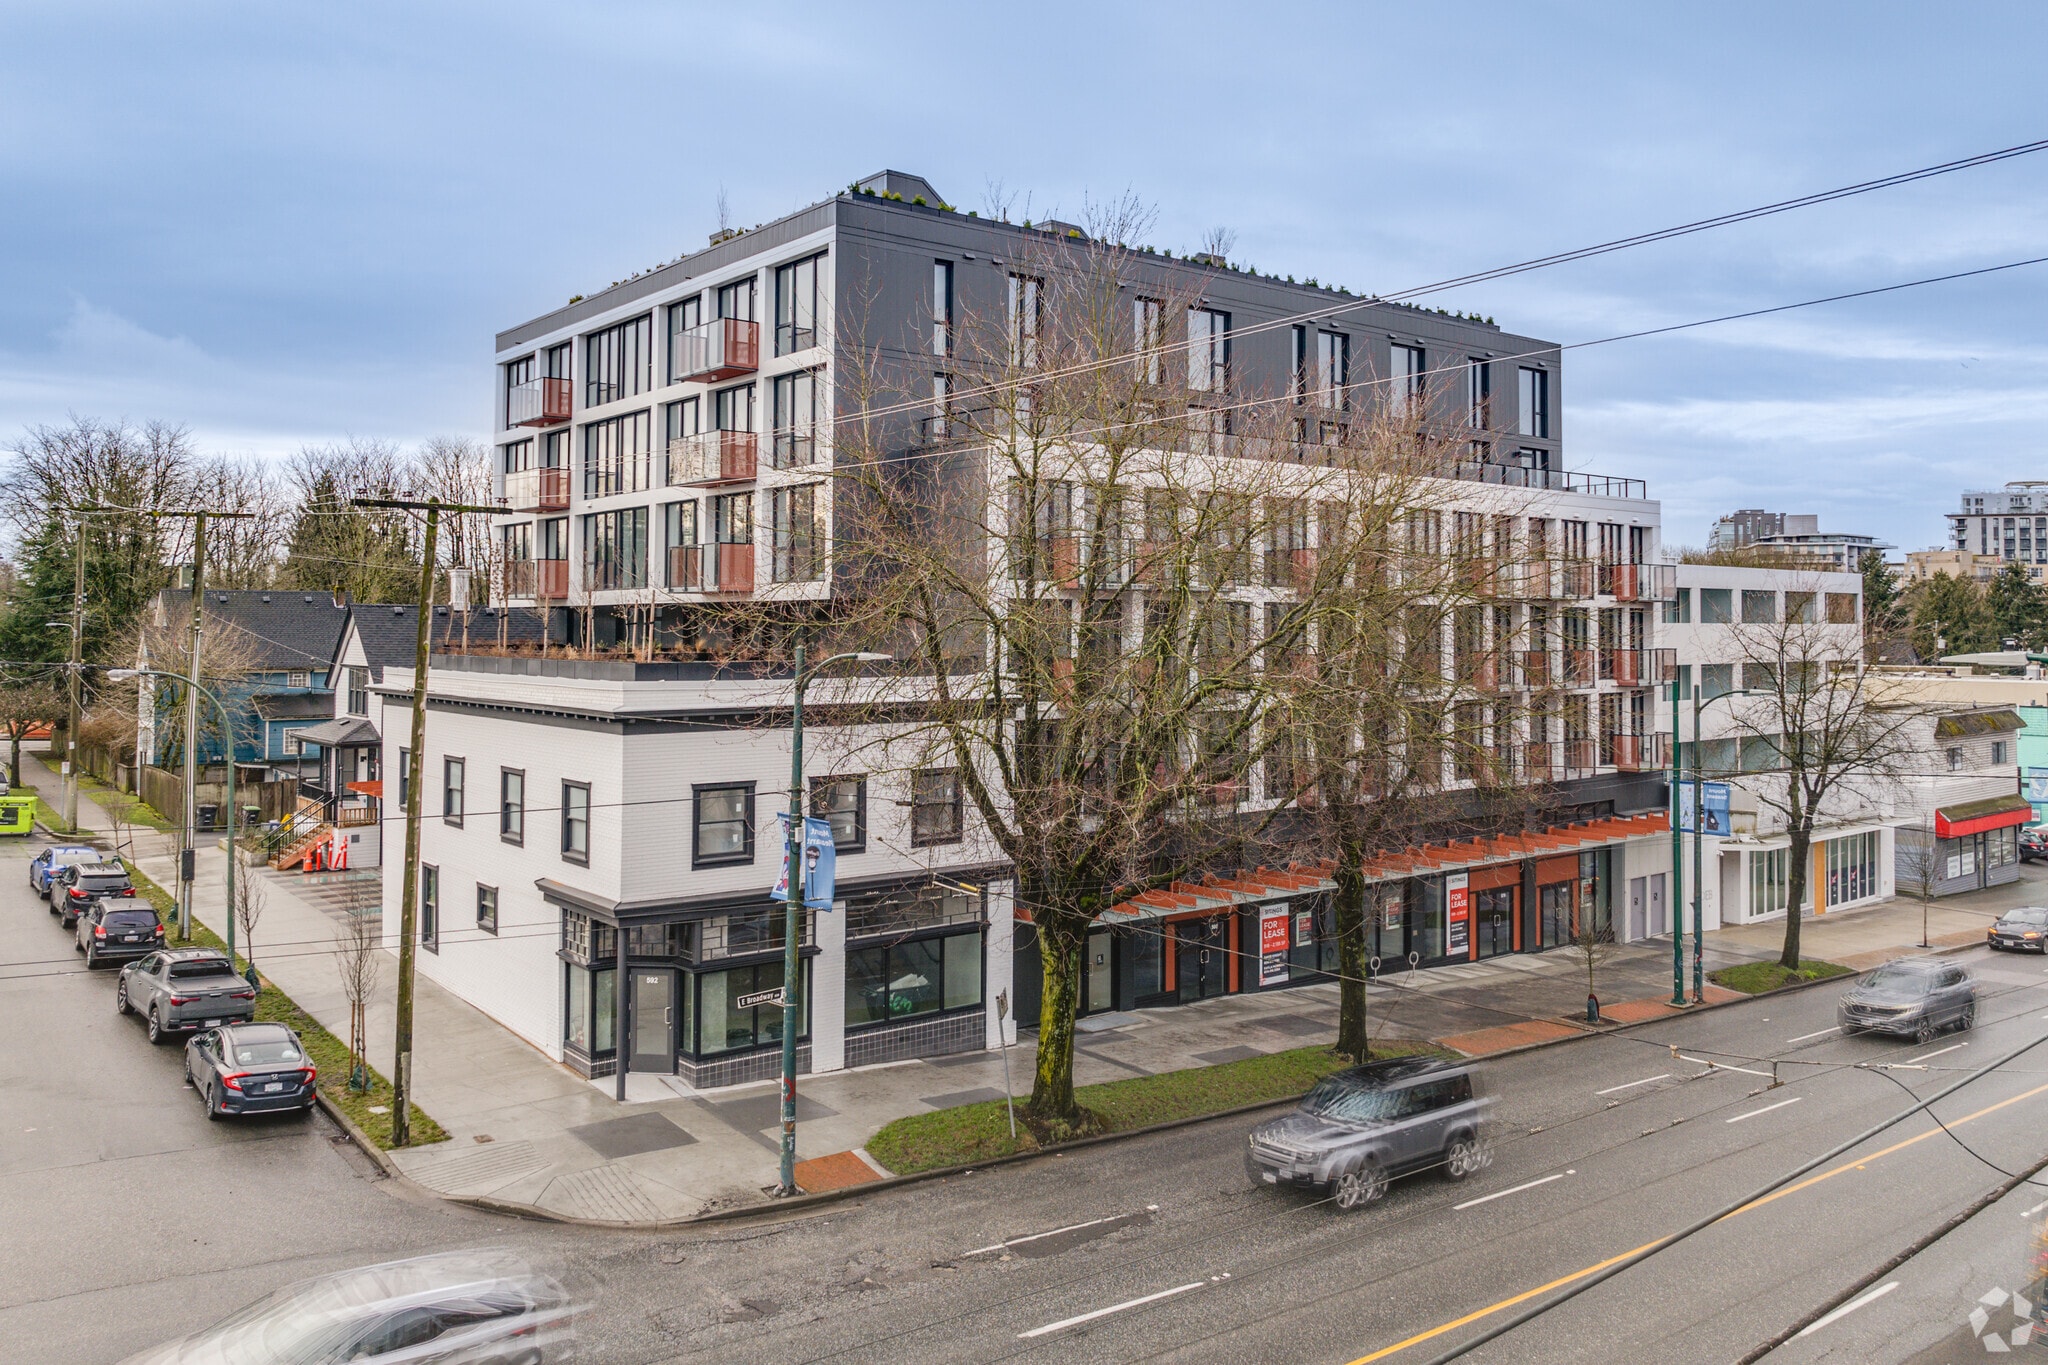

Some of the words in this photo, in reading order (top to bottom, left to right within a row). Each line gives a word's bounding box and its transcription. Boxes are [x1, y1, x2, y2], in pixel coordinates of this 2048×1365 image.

[1451, 893, 1462, 902] FOR
[1451, 898, 1468, 909] LEASE
[1263, 920, 1278, 930] FOR
[1263, 928, 1286, 939] LEASE
[741, 998, 746, 1006] E
[746, 993, 774, 1004] Broadway
